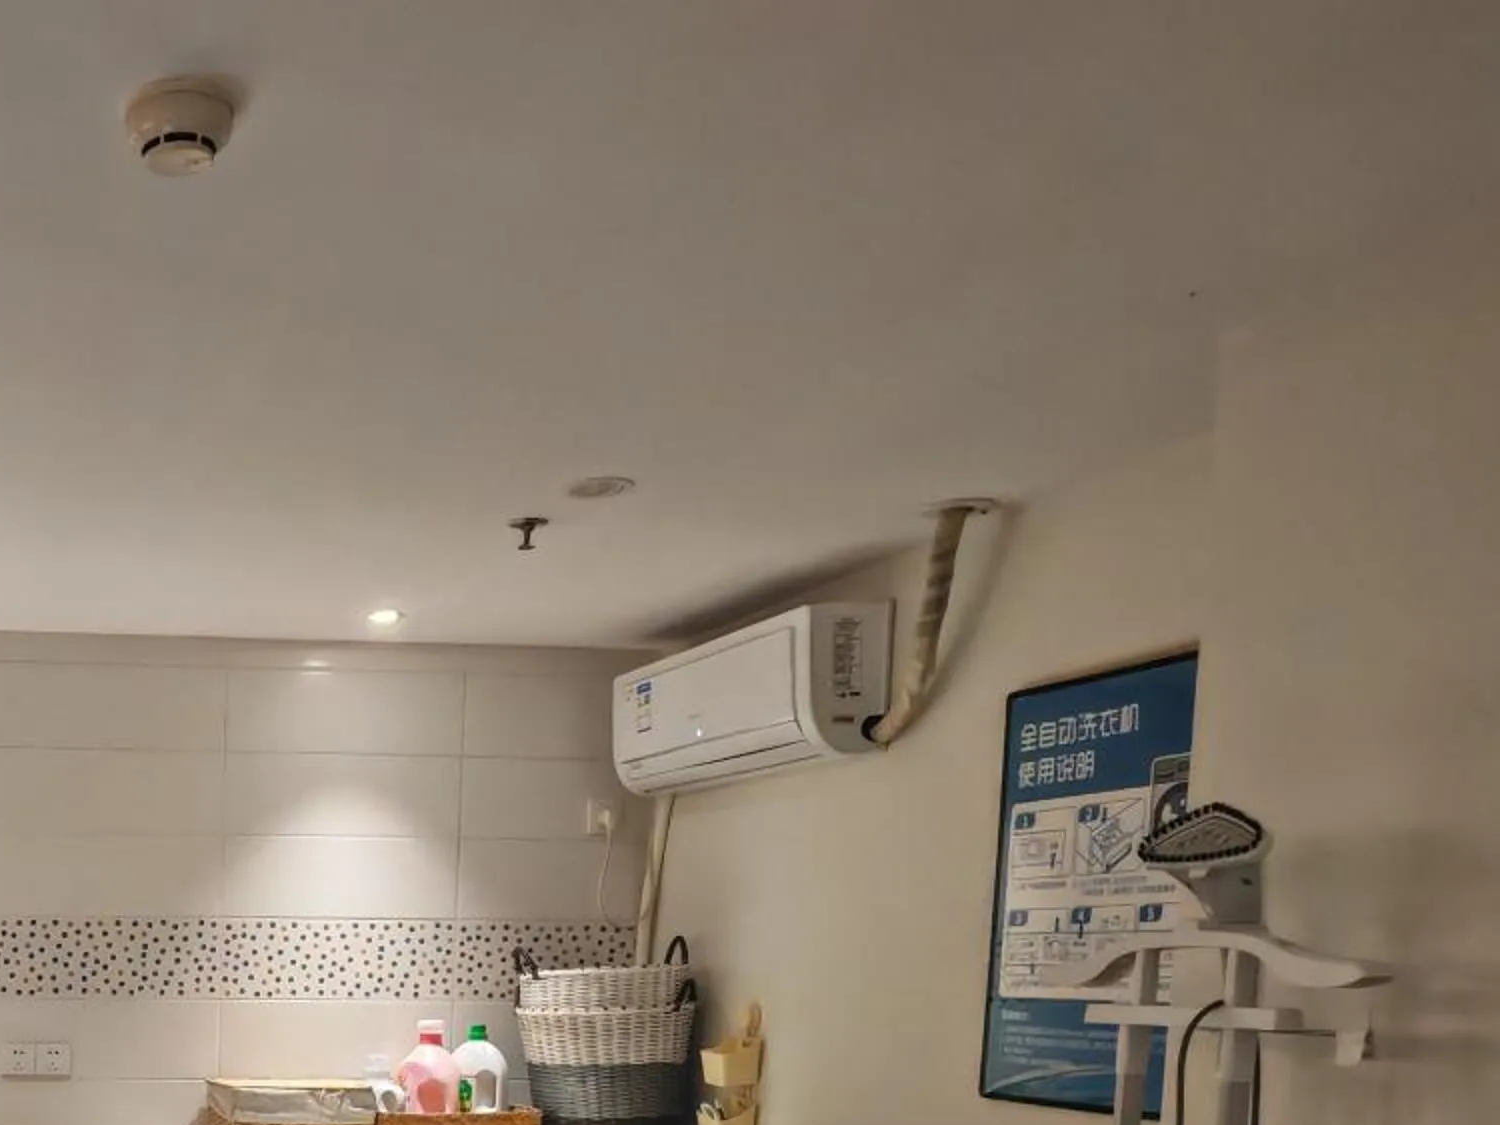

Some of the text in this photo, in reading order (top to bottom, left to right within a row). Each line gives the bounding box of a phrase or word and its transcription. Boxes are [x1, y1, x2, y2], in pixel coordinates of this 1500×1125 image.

[1019, 703, 1140, 752] 全自动洗衣机
[1018, 750, 1096, 789] 使用说明
